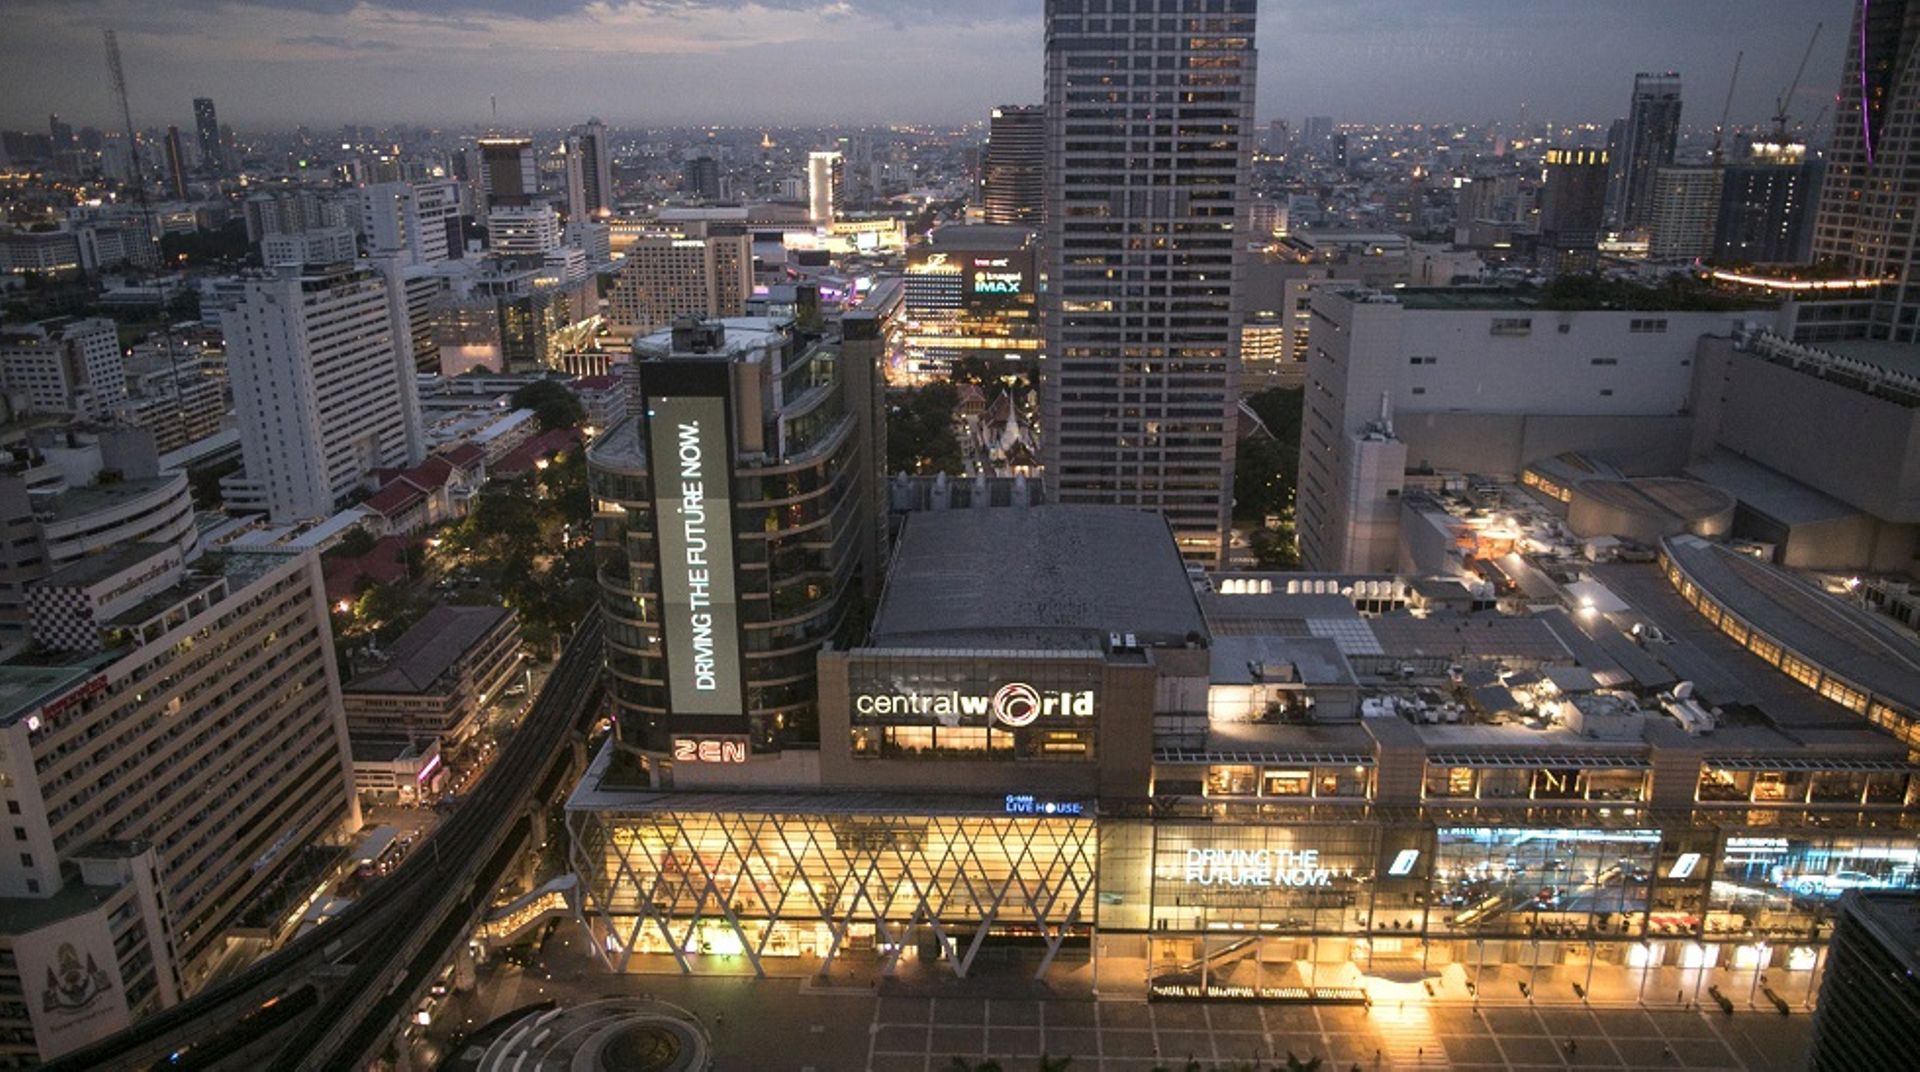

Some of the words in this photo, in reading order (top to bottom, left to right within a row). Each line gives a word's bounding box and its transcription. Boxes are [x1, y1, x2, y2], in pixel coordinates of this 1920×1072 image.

[974, 281, 1020, 293] IMAX
[677, 420, 702, 477] NOW.
[682, 481, 708, 565] FUTURE
[688, 569, 711, 612] THE
[691, 613, 716, 691] DRIVING
[856, 682, 1094, 727] centralworld
[674, 739, 745, 763] ZEN
[1006, 802, 1033, 813] LIVE
[1035, 802, 1082, 814] HOUSE
[1186, 848, 1271, 867] DRIVING
[1274, 848, 1319, 868] THE
[1185, 866, 1271, 886] FUTURE
[1274, 867, 1333, 887] NOW.
